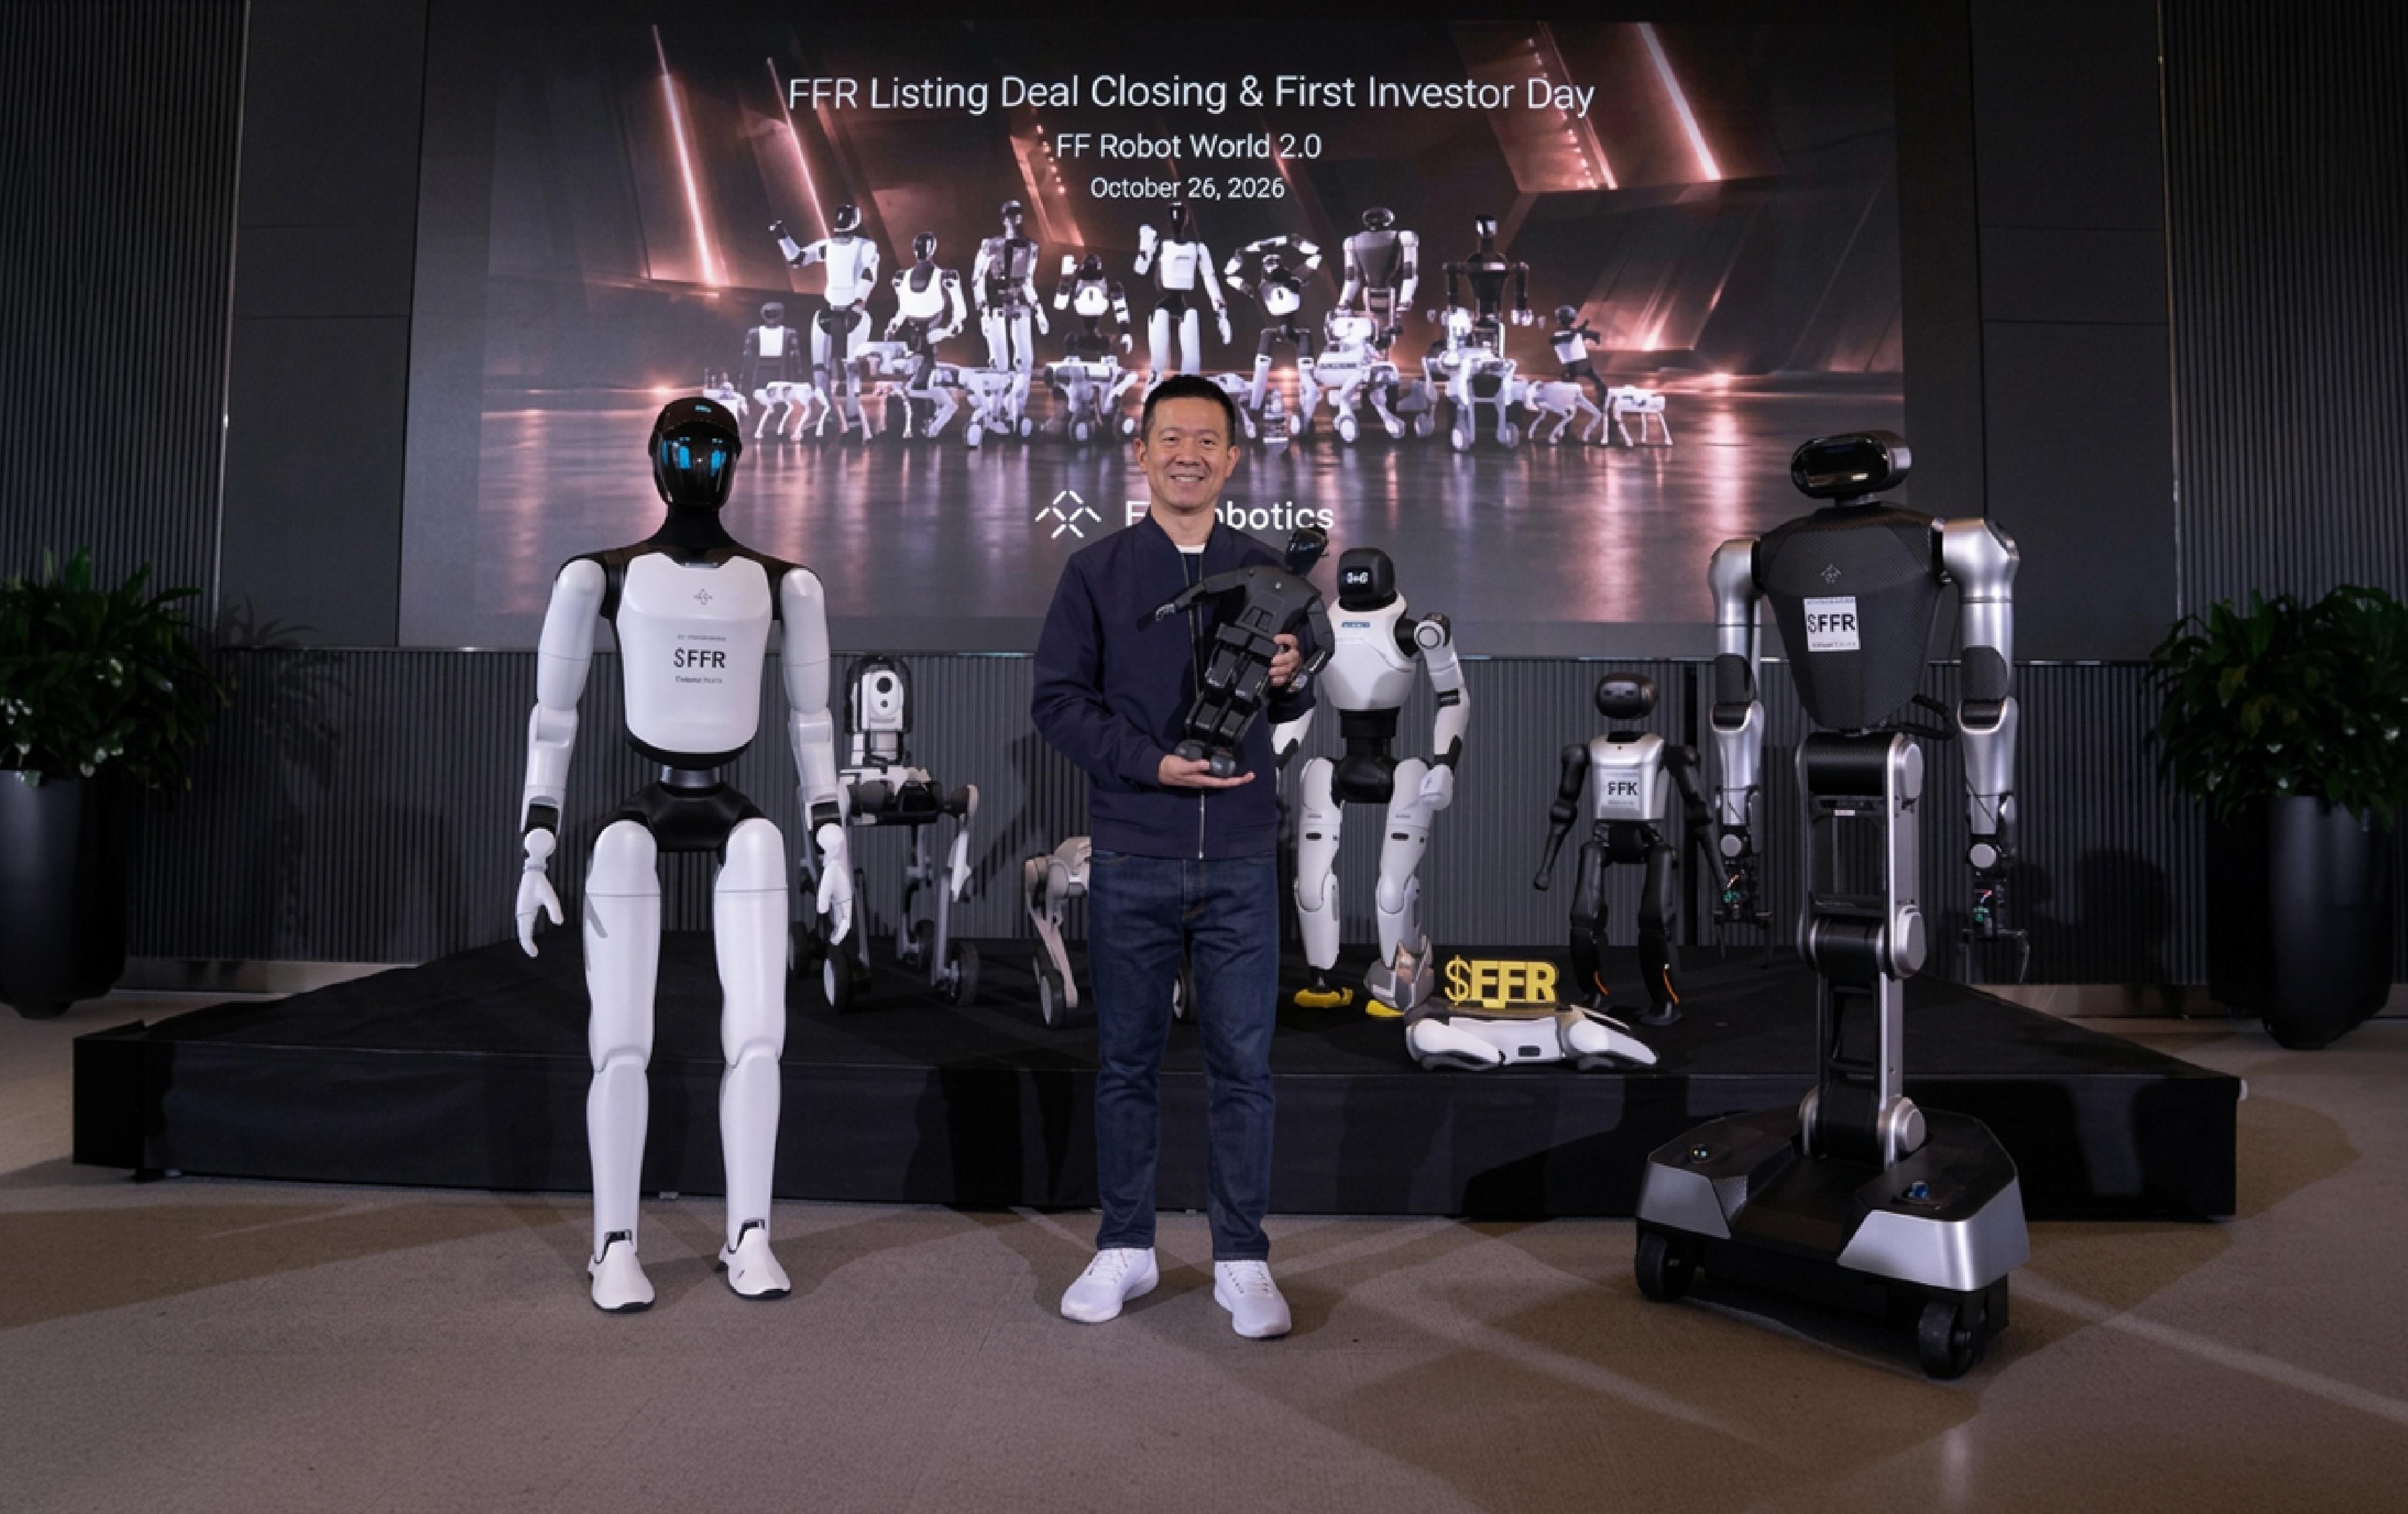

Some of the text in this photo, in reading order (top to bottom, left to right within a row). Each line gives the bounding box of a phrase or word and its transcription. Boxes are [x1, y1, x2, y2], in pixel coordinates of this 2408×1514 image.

[788, 75, 1595, 118] FFR Listing Deal Closing & First Investor Day
[1056, 132, 1323, 159] FF Robot World 2.0
[1090, 176, 1287, 201] October 26, 2026
[1214, 500, 1335, 530] botics
[673, 646, 727, 669] $FFR
[1444, 953, 1558, 1007] $FFR
